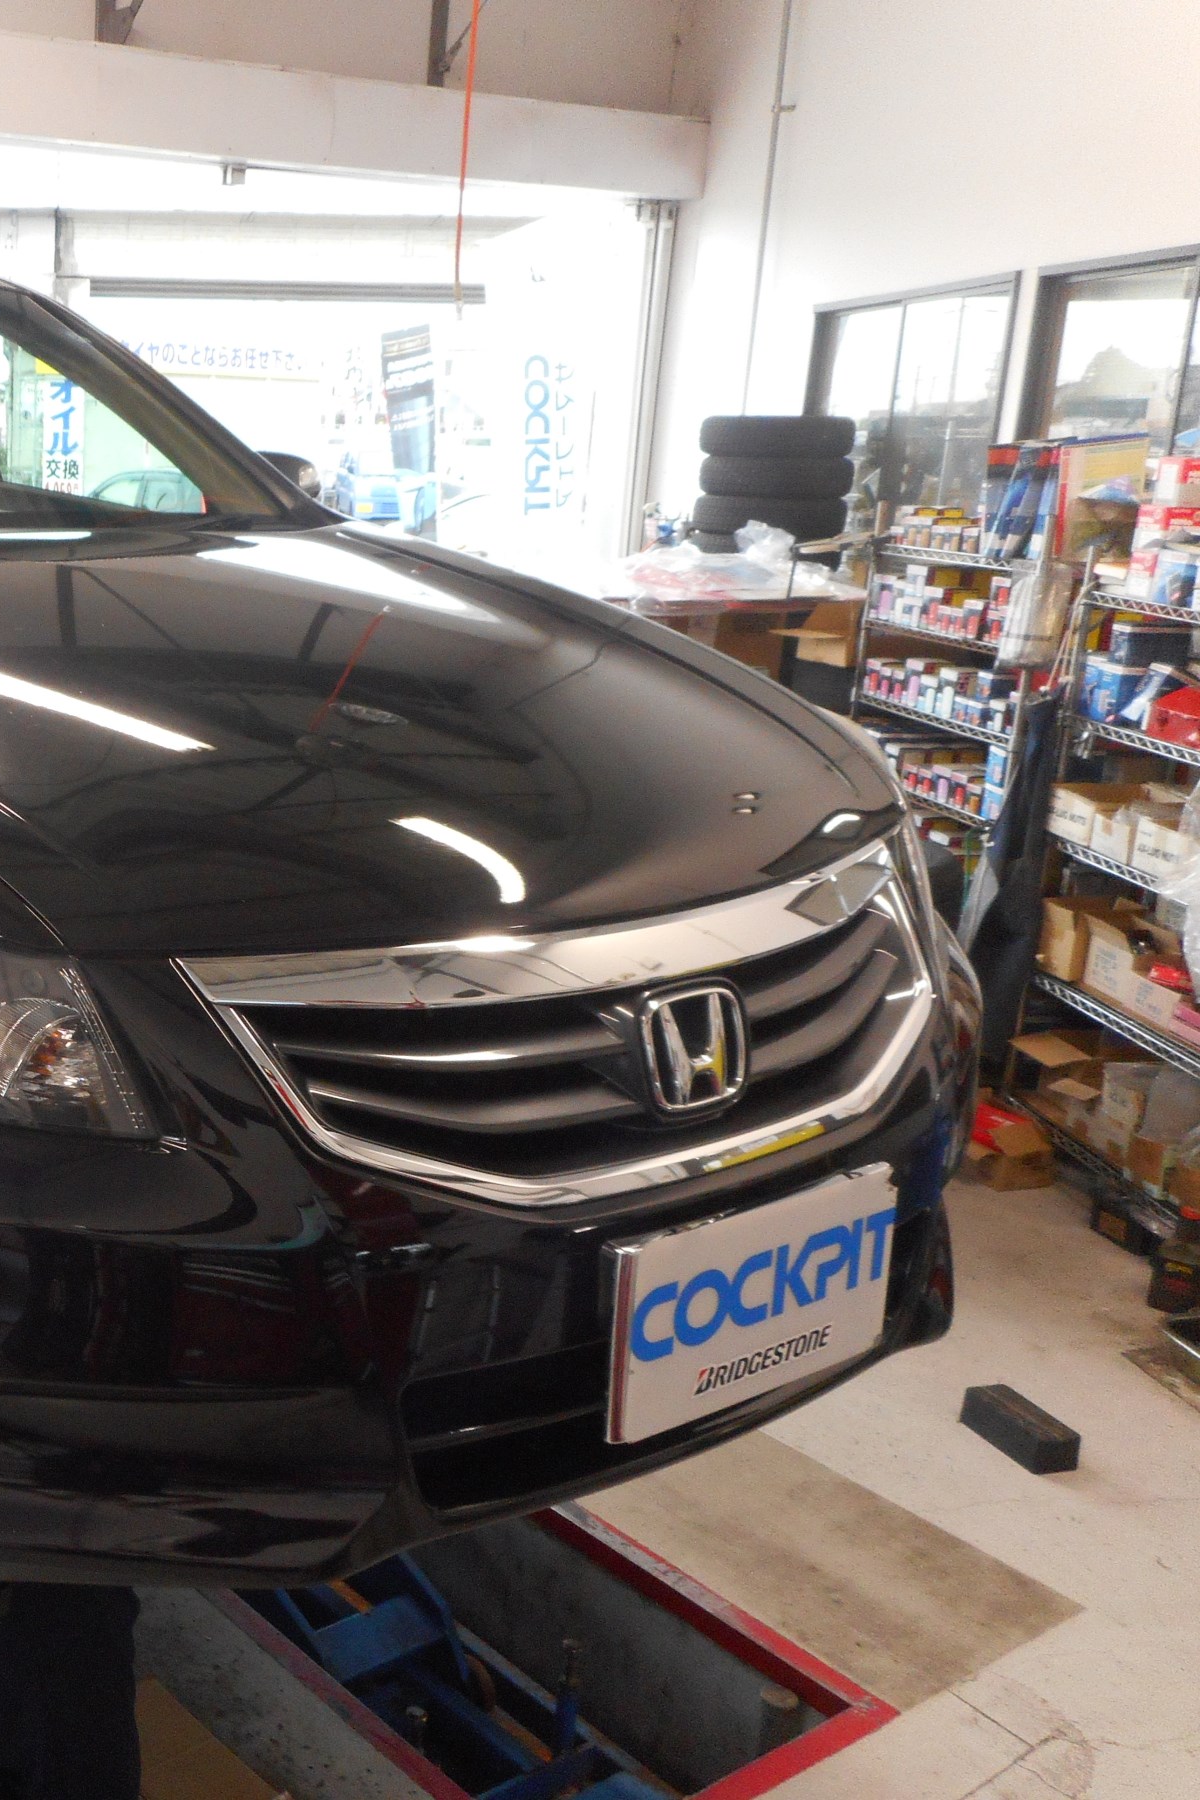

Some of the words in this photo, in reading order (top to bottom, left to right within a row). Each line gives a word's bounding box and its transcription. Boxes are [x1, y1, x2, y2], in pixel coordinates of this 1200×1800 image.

[46, 379, 80, 457] オイル
[45, 459, 80, 480] 交換
[629, 1206, 897, 1363] COCKPIT
[693, 1324, 833, 1396] BRIDGESTONE
